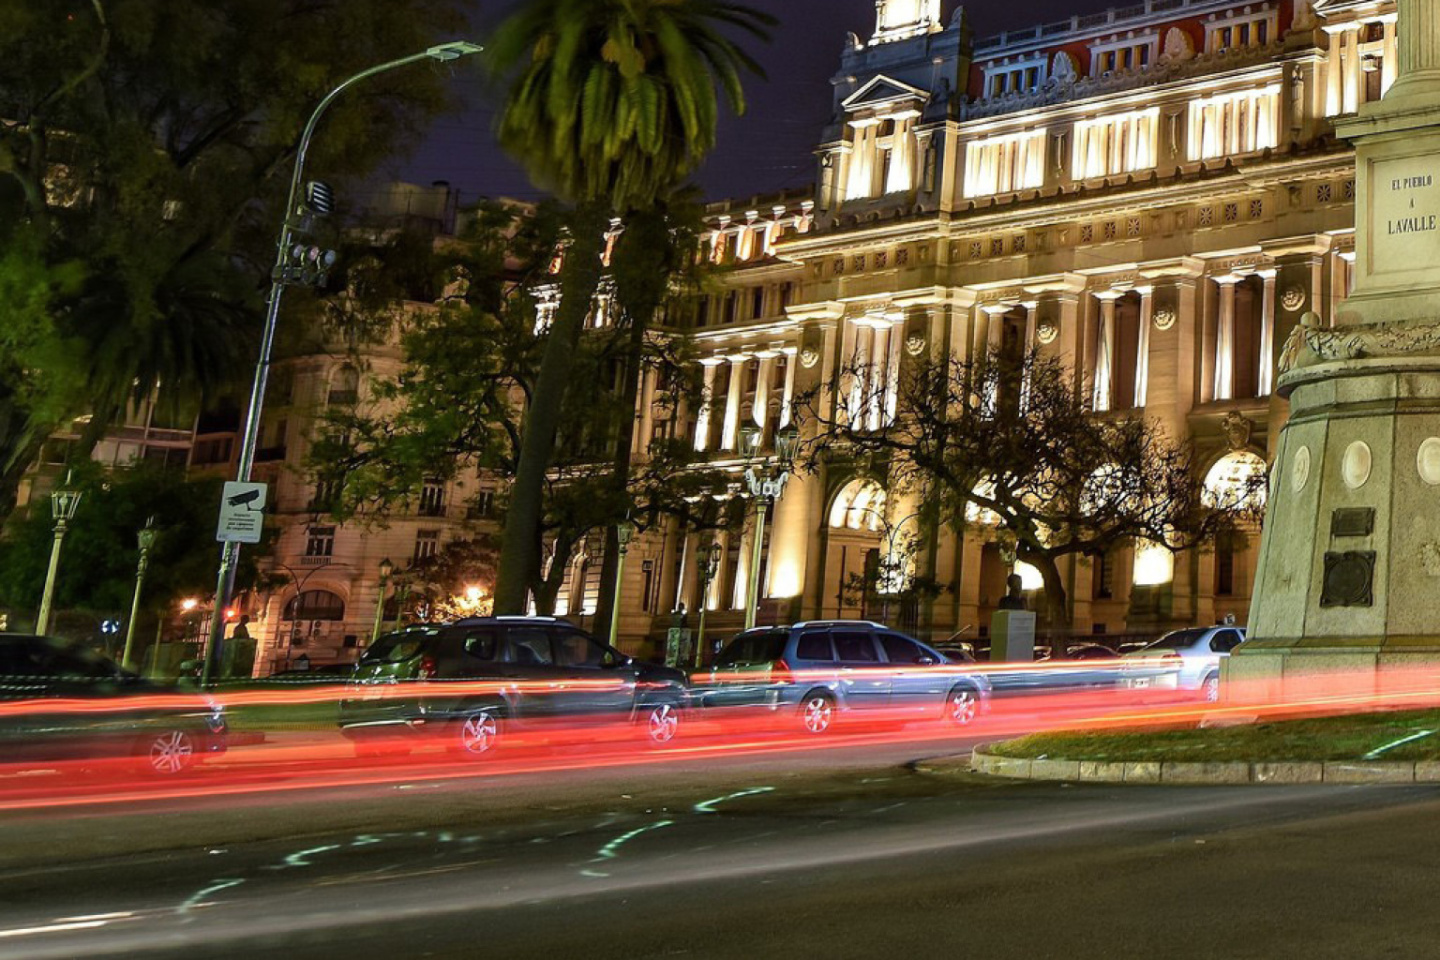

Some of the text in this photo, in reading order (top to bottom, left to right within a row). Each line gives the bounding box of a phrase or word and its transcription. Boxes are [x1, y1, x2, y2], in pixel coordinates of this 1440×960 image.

[1392, 175, 1432, 190] EL PUEBLO
[1388, 215, 1436, 234] LAVALLE
